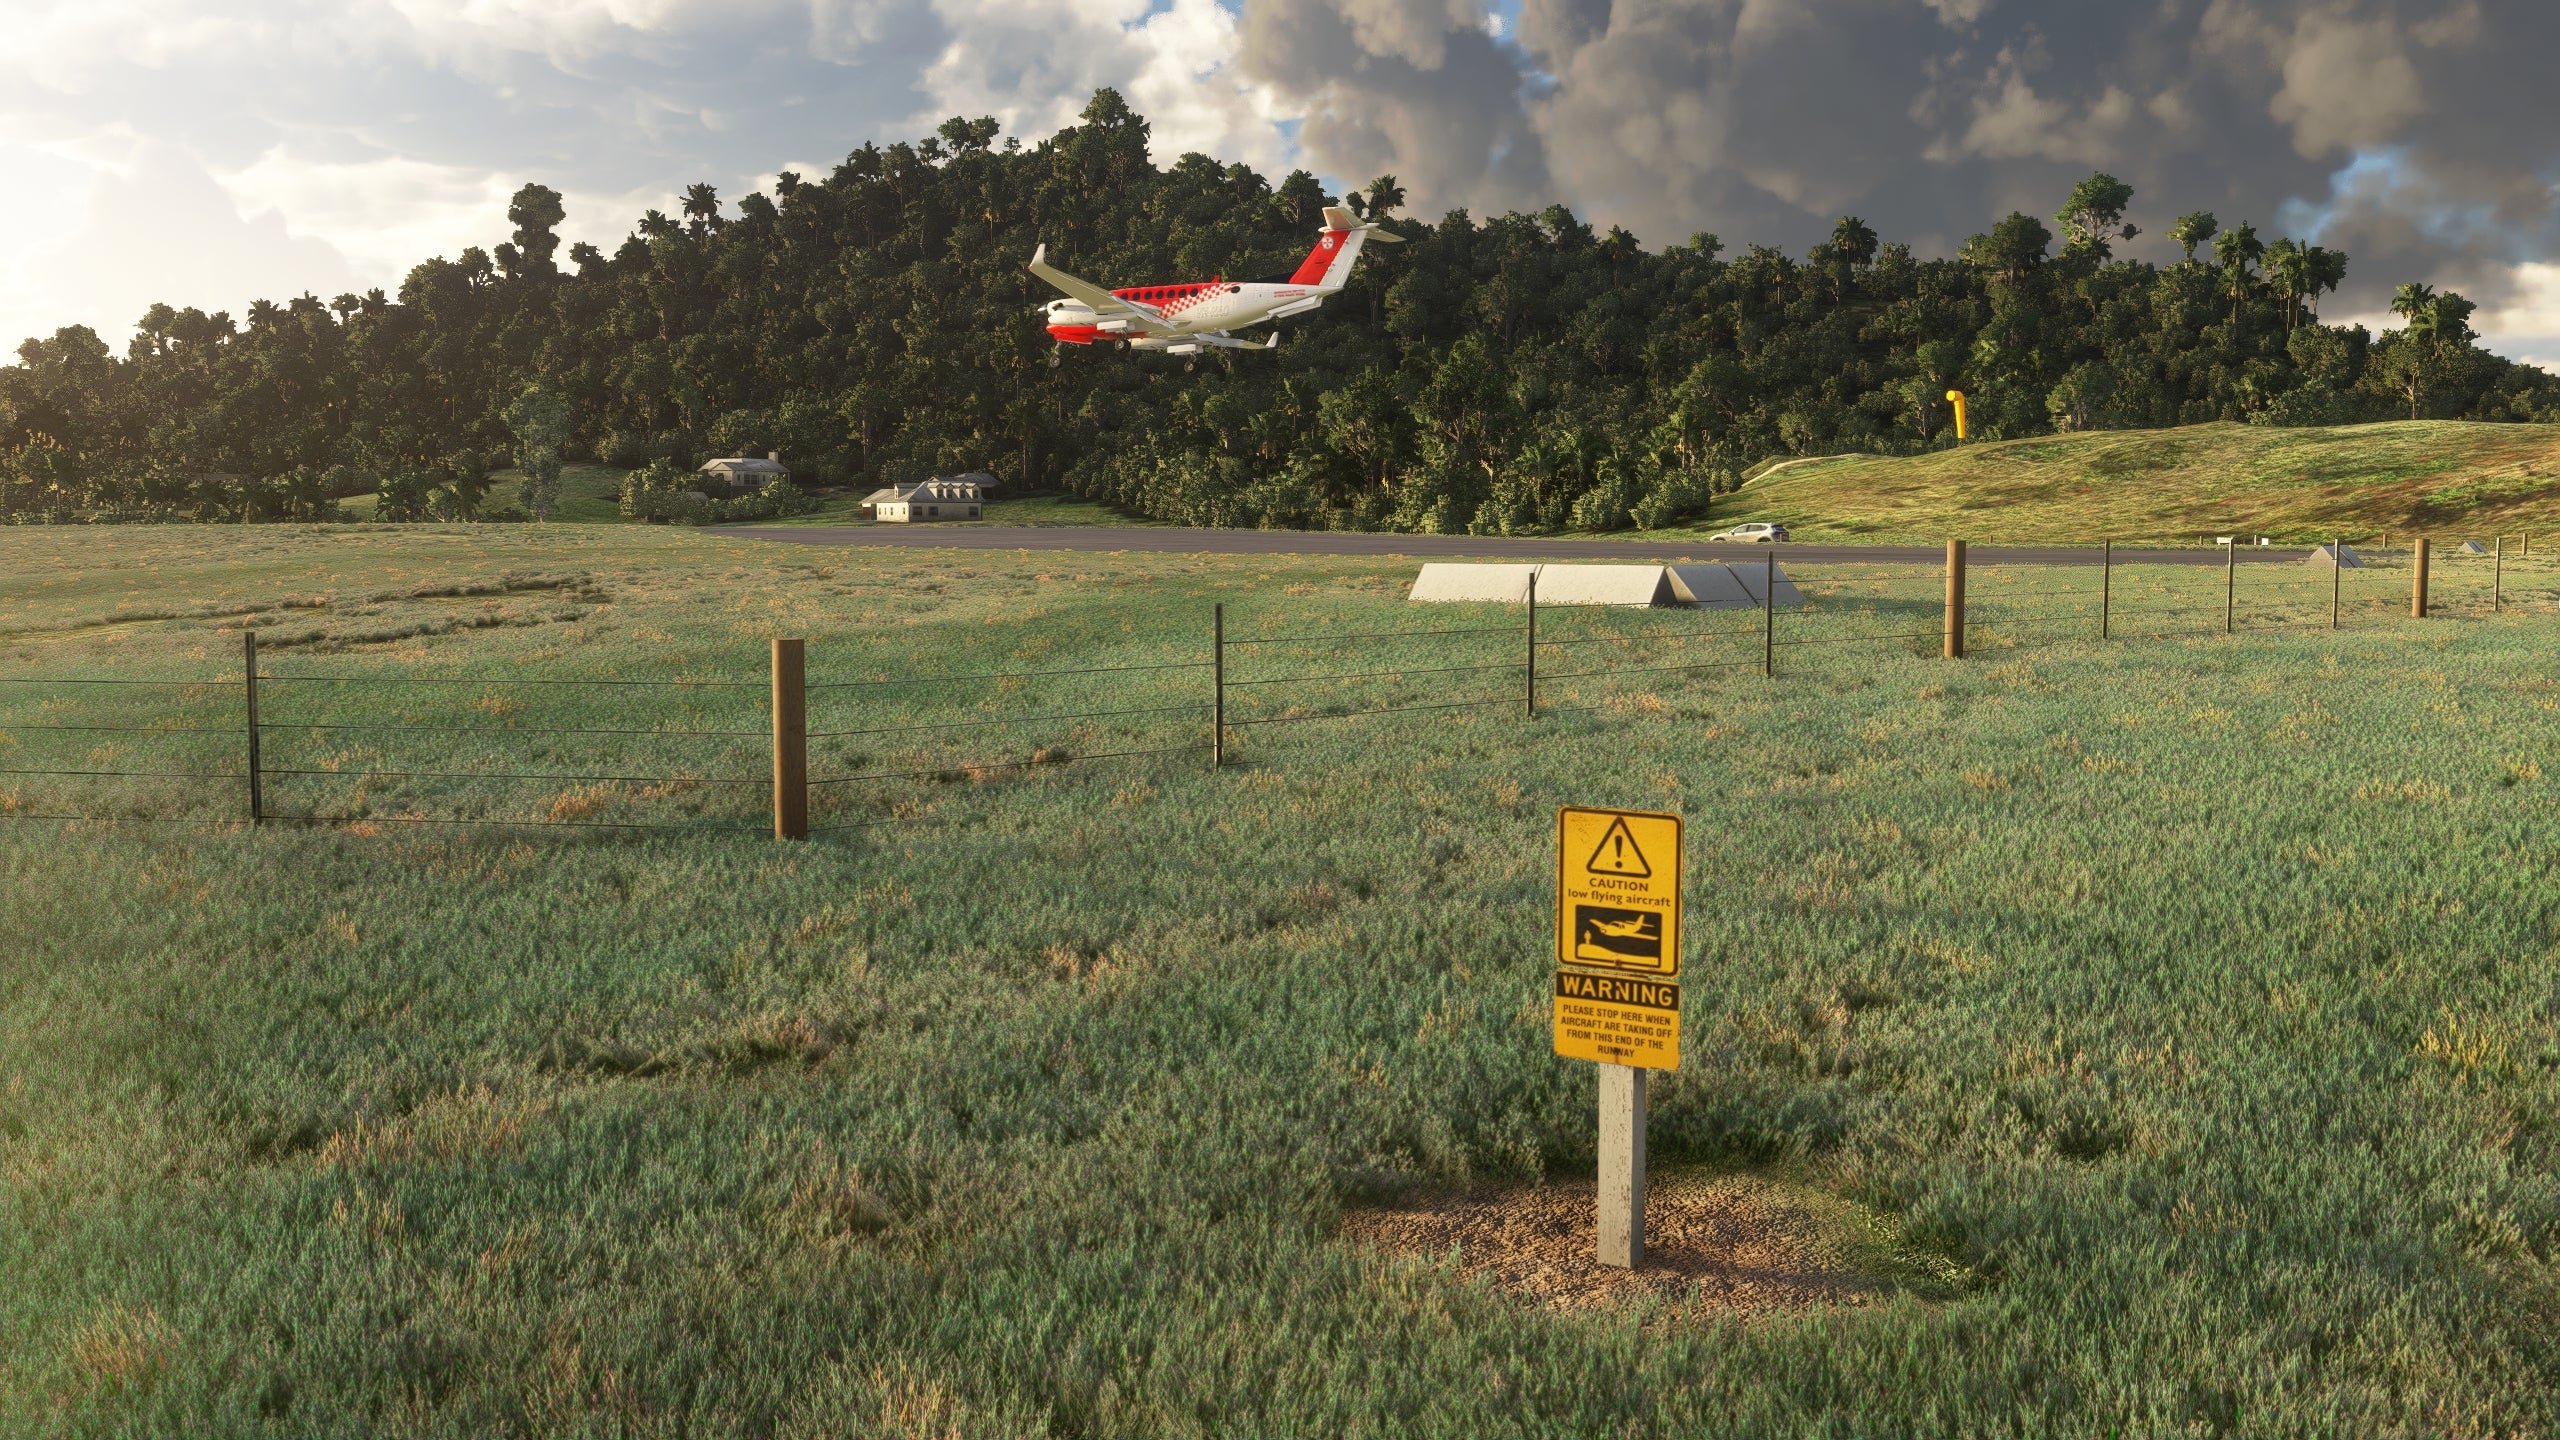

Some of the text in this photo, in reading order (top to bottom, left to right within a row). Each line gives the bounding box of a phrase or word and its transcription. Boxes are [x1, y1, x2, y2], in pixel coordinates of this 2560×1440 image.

[1589, 878, 1649, 892] CAUTION
[1568, 888, 1671, 907] low flying aircraft
[1562, 975, 1673, 1007] WARNING
[1563, 1004, 1671, 1026] PLEASE STOP HERE WHEN
[1561, 1016, 1672, 1038] AIRCRAFT ARE TAKING OFF
[1567, 1029, 1664, 1050] FROM THIS END OF THE
